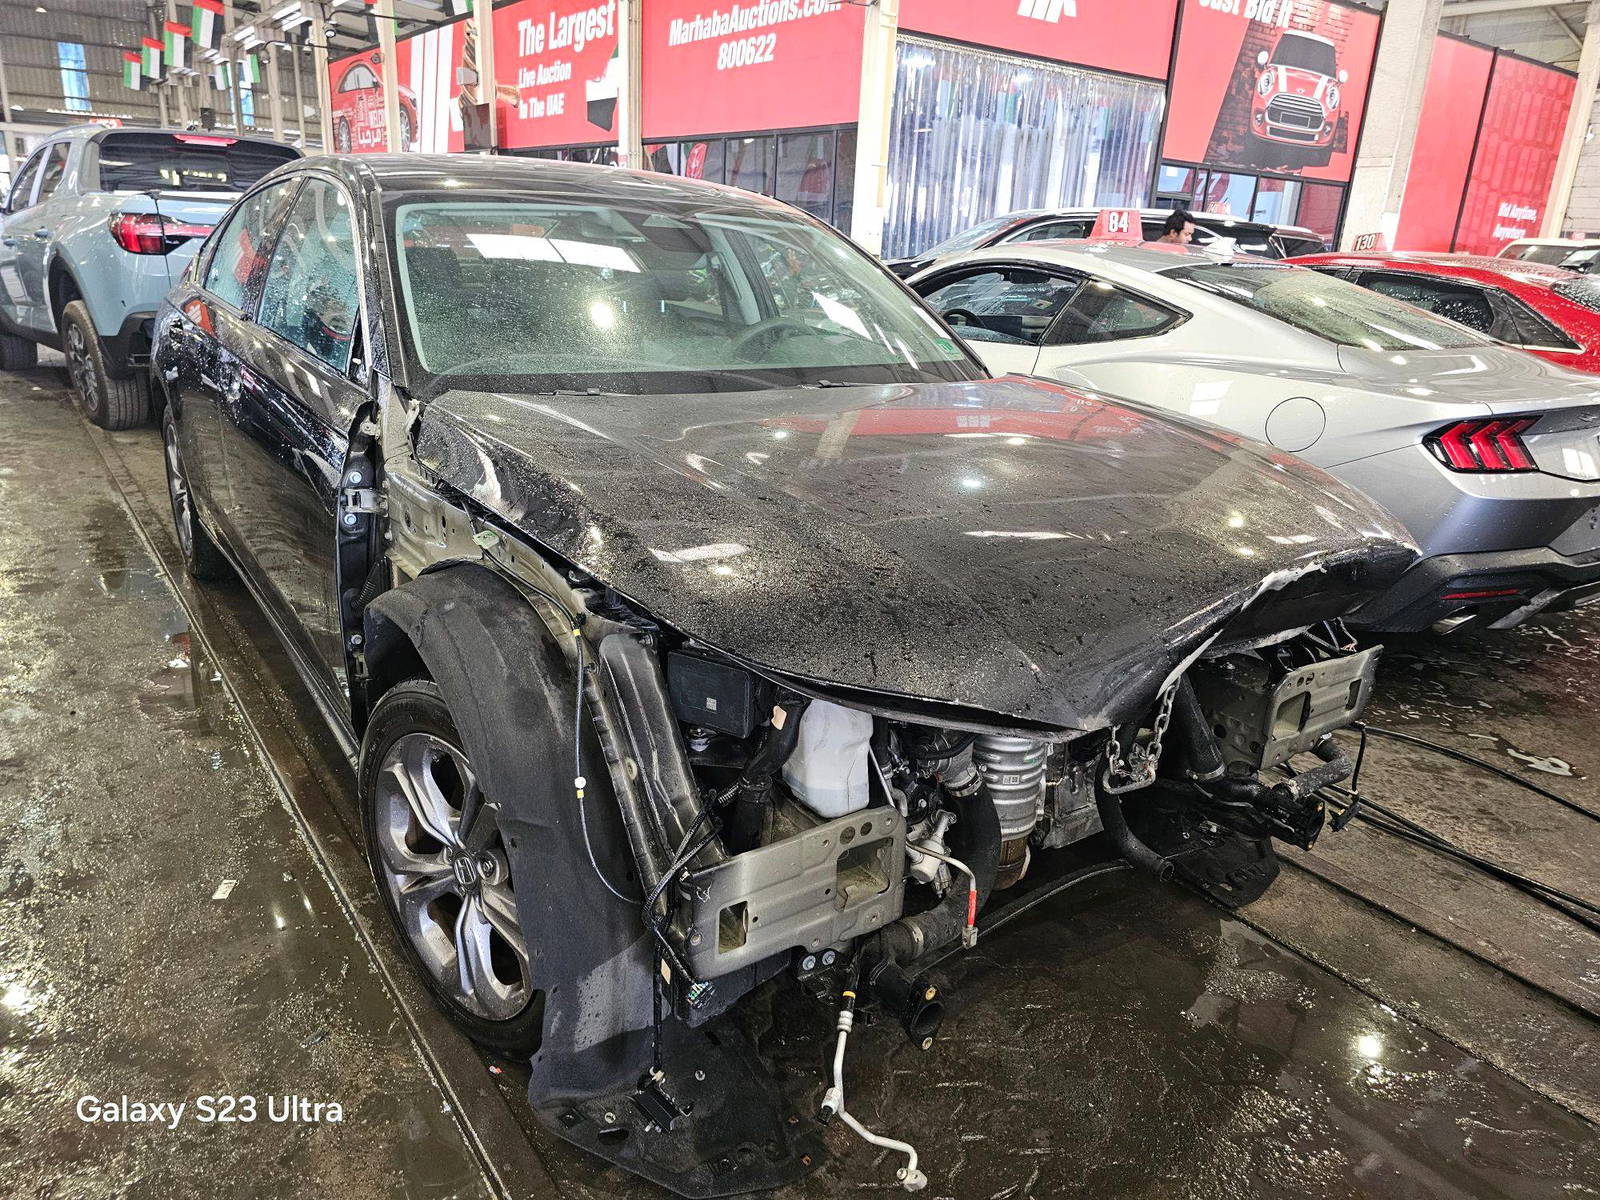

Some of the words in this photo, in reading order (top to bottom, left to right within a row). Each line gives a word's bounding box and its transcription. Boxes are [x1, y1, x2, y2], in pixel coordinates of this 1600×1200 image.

[1243, 0, 1277, 24] Bid
[518, 19, 545, 57] The
[548, 0, 616, 53] Largest
[717, 33, 777, 70] 800622
[518, 67, 536, 88] Live
[536, 60, 572, 85] Auction
[529, 96, 545, 118] The
[546, 92, 565, 116] UAE
[1109, 211, 1128, 232] 84
[1355, 234, 1376, 251] 130
